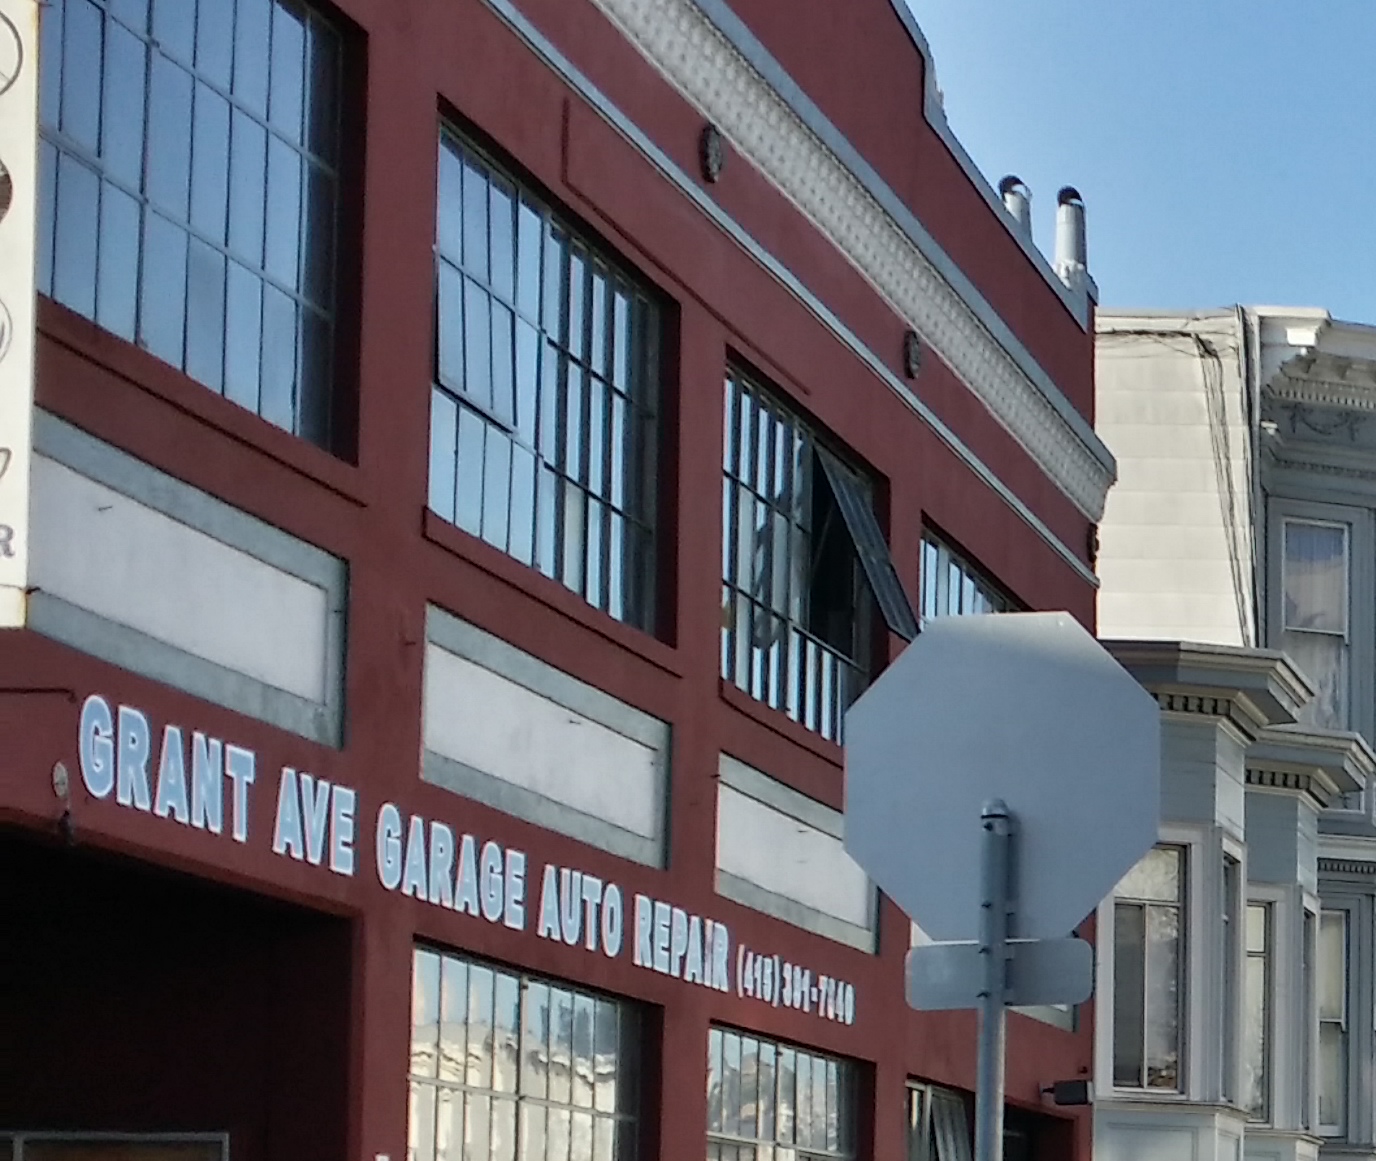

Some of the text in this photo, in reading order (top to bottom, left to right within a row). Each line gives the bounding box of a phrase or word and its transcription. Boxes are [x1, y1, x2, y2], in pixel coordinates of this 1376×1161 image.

[79, 694, 256, 842] GRANT
[272, 766, 355, 876] AVE
[376, 802, 527, 930] GARAGE
[537, 864, 624, 958] AUTO
[632, 893, 730, 993] REPAIR
